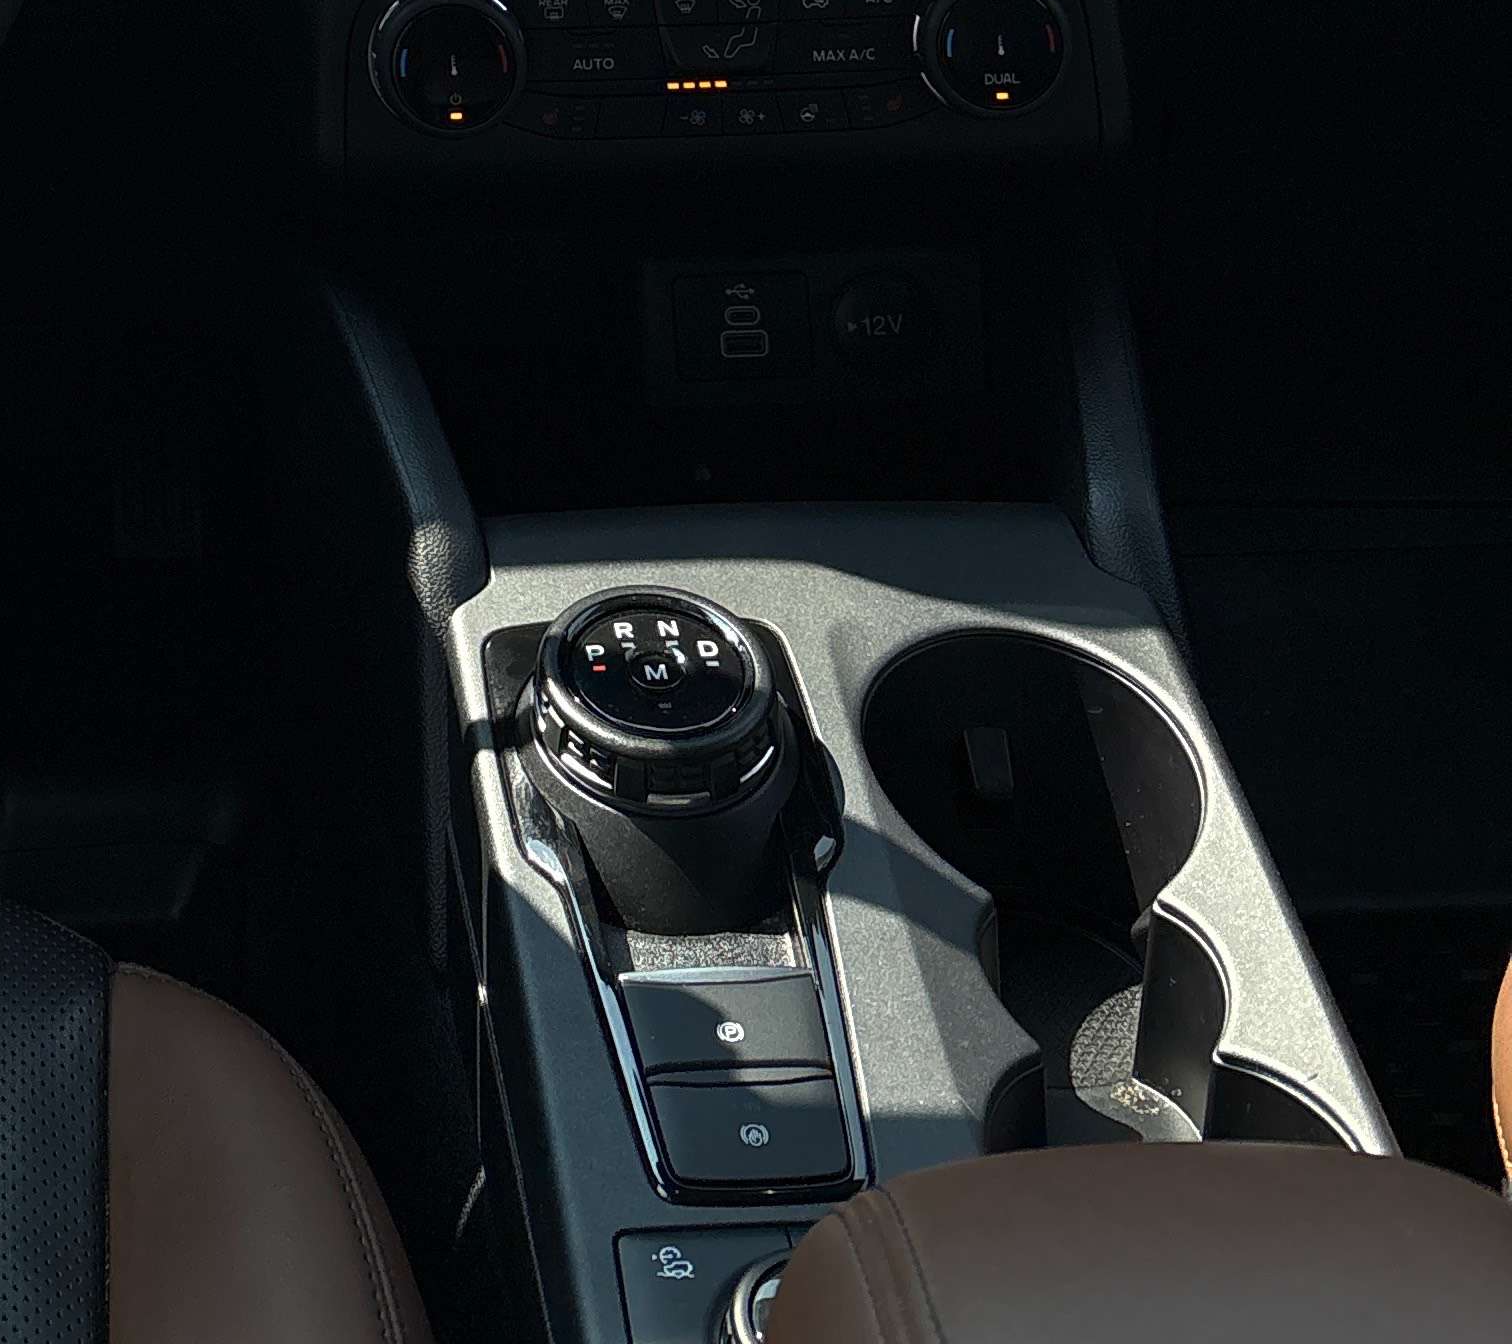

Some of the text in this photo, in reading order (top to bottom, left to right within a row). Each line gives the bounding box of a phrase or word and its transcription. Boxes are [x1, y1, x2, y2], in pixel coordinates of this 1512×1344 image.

[572, 56, 615, 71] AUTO
[812, 46, 876, 62] MAX A/C
[983, 72, 1020, 86] DUAL
[613, 621, 635, 640] R
[656, 619, 679, 638] N
[585, 643, 605, 662] P
[696, 639, 719, 658] D
[644, 663, 669, 682] M
